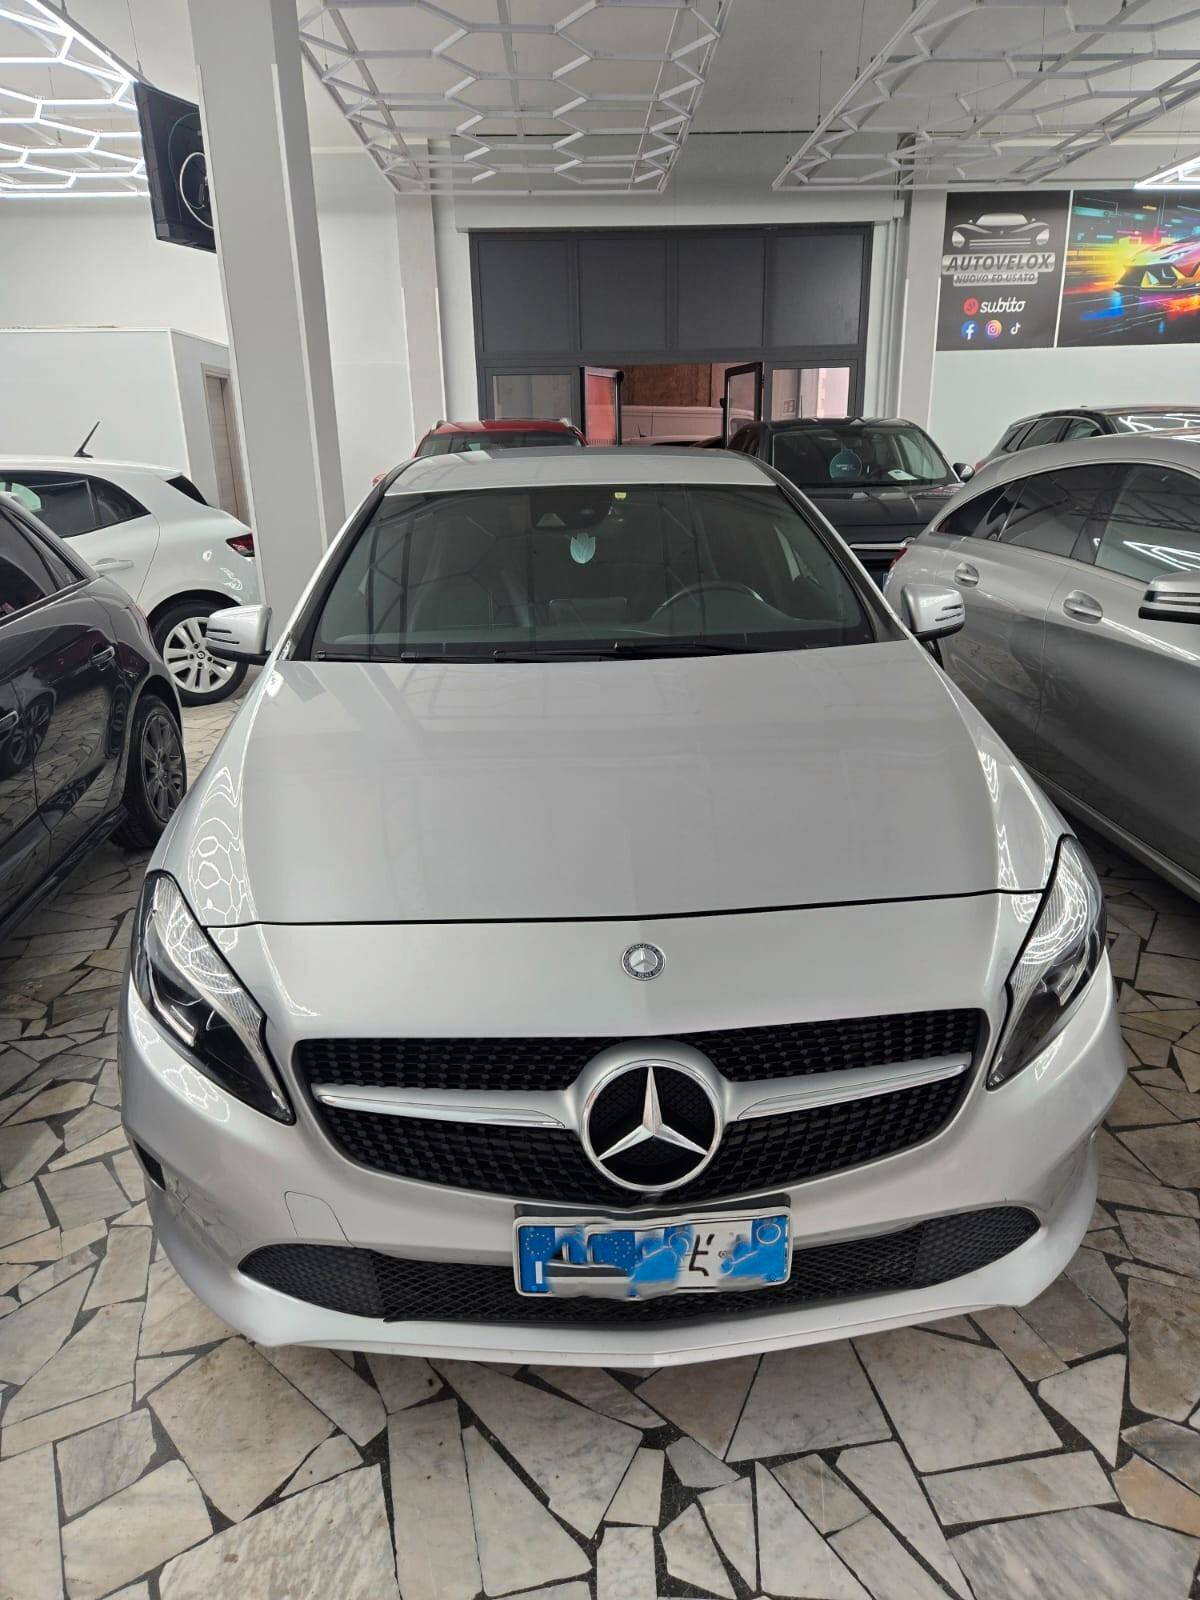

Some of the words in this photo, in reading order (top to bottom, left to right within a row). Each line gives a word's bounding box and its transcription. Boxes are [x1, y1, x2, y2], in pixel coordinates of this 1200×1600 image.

[946, 254, 1051, 271] AUTOVELOX
[954, 273, 988, 284] NUOVO
[1005, 272, 1036, 283] USATO
[980, 297, 1026, 313] subito
